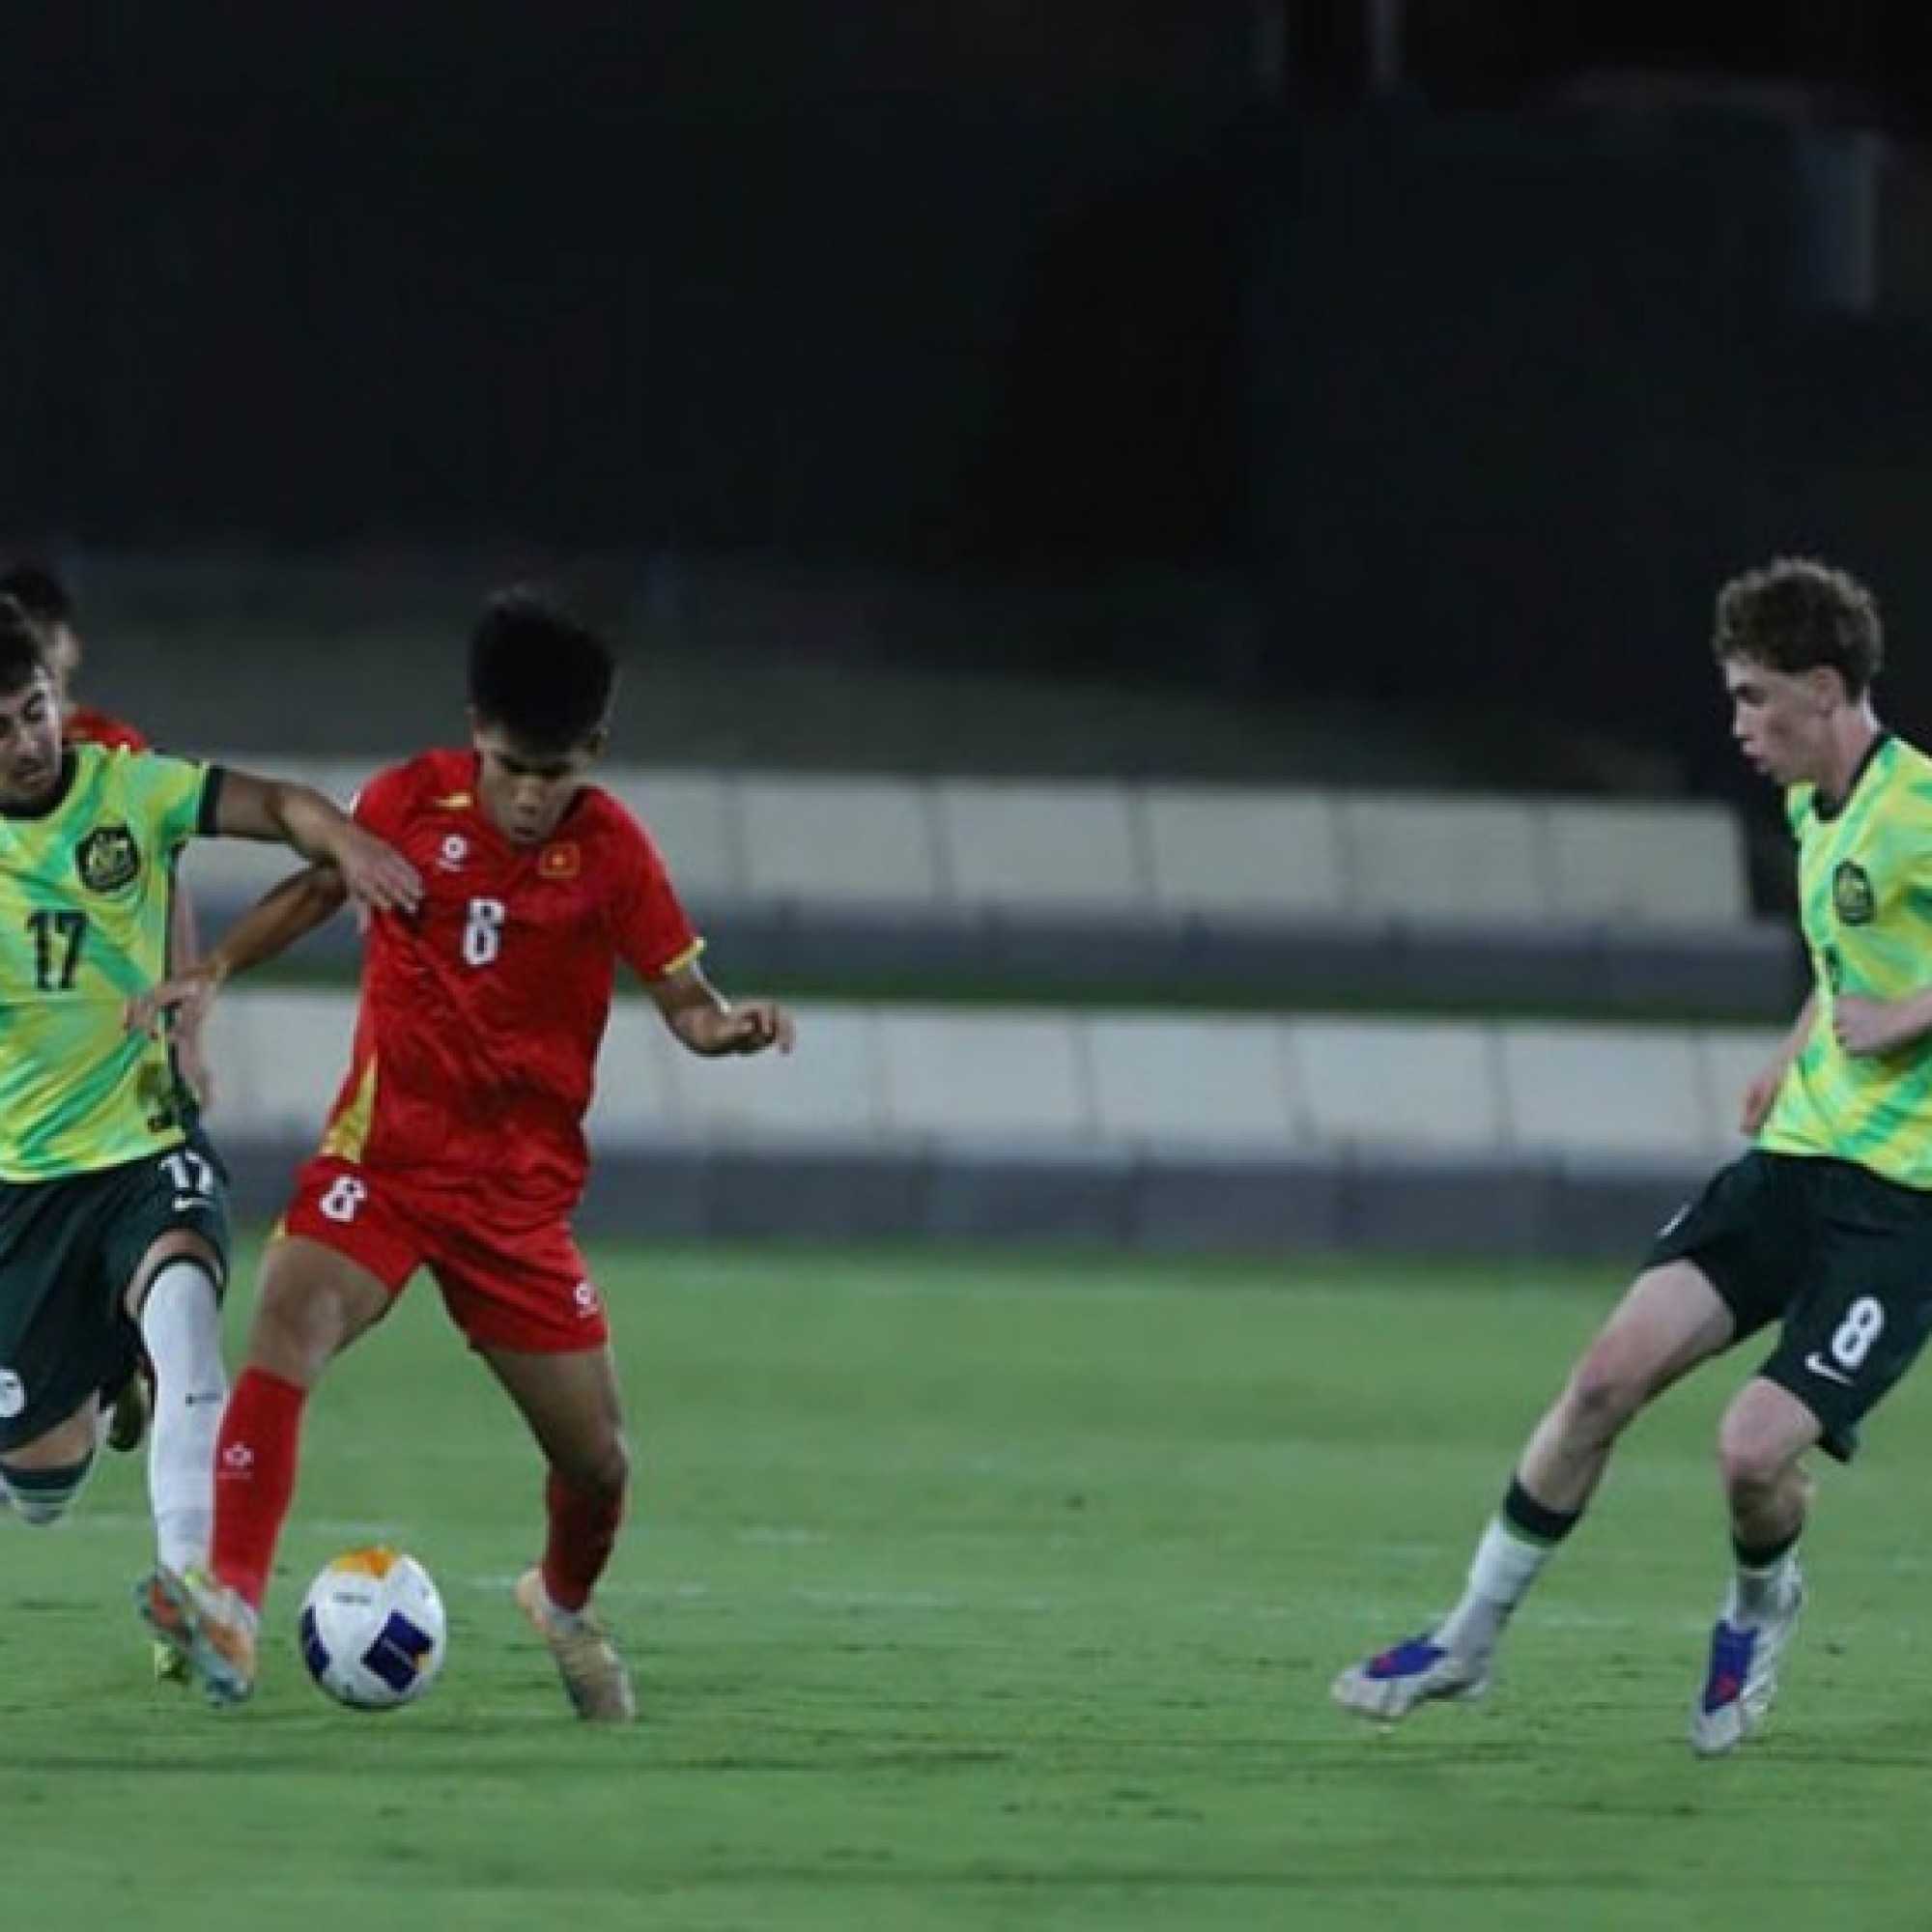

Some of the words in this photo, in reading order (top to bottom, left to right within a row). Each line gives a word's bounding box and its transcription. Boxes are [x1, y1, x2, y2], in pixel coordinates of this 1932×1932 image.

[26, 910, 86, 990] 17
[463, 898, 506, 966] 8
[320, 1175, 367, 1223] 8
[1831, 1296, 1884, 1369] 8
